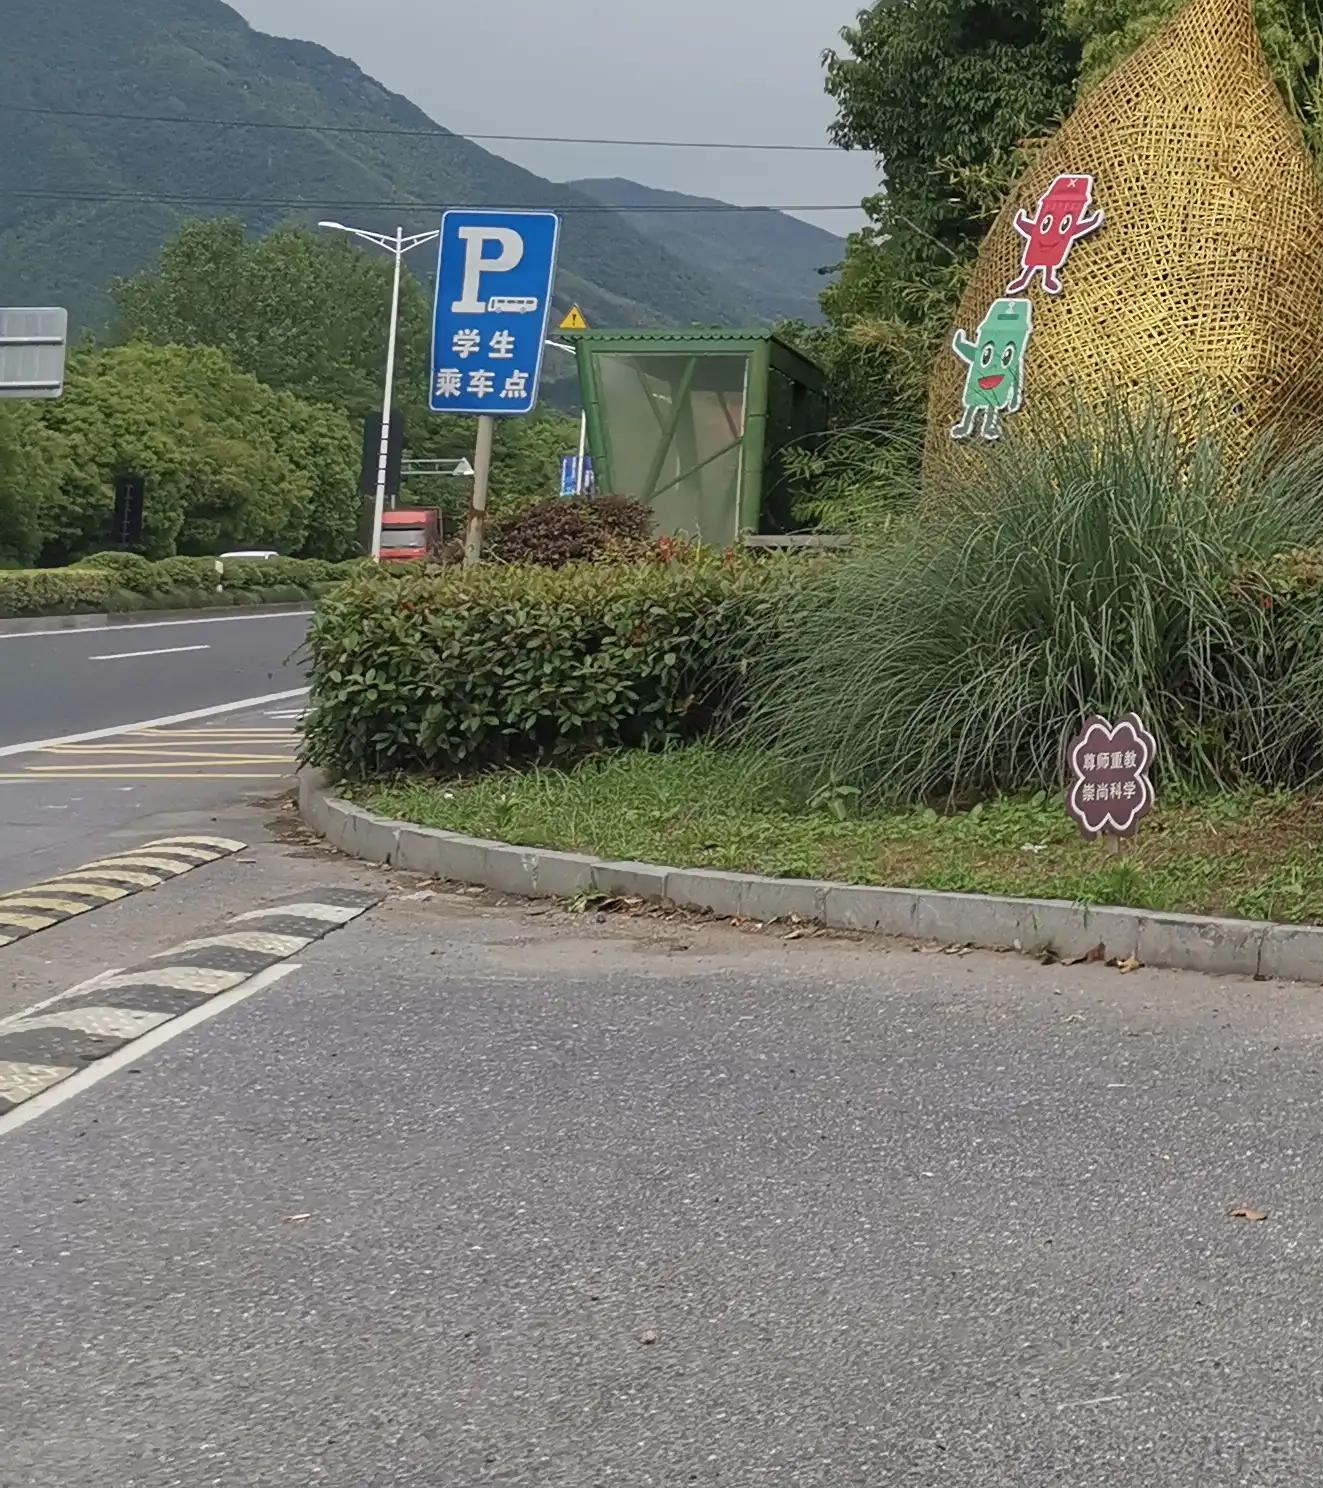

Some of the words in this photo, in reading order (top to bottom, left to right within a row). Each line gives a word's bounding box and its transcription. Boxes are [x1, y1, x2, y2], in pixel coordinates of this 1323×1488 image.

[451, 226, 524, 313] P
[451, 328, 516, 359] 学生
[434, 367, 530, 399] 乘车点
[1082, 749, 1138, 772] 尊师重教
[1081, 780, 1137, 802] 崇尚科学
